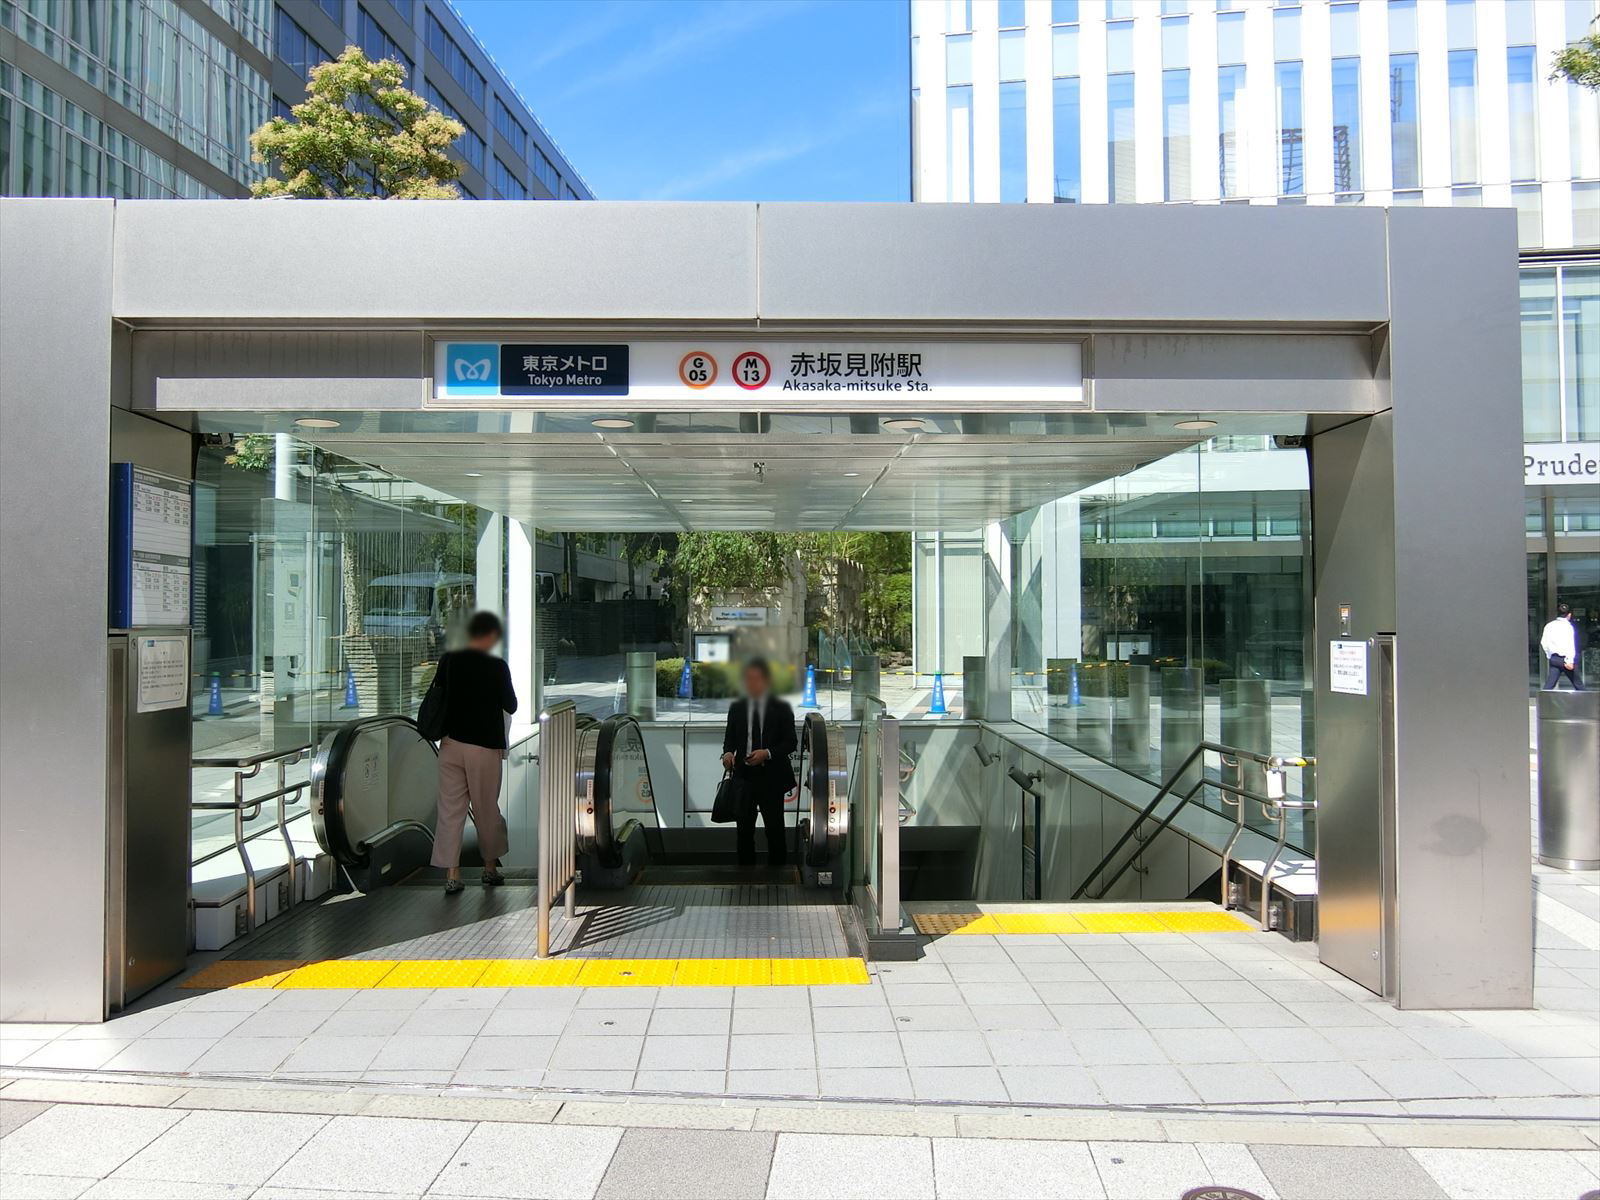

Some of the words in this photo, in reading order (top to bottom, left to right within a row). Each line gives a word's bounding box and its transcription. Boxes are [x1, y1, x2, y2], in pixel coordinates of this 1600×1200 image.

[522, 355, 608, 372] 東京メトロ
[693, 357, 704, 369] G
[745, 358, 758, 369] M
[790, 352, 922, 378] 赤坂見附駅
[527, 373, 563, 388] Tokyo
[566, 373, 602, 386] Metro
[688, 369, 707, 382] 05
[743, 370, 760, 382] 13
[782, 379, 902, 392] Akasaka-mitsuke
[906, 379, 933, 392] Sta.
[1523, 452, 1600, 476] Prude
